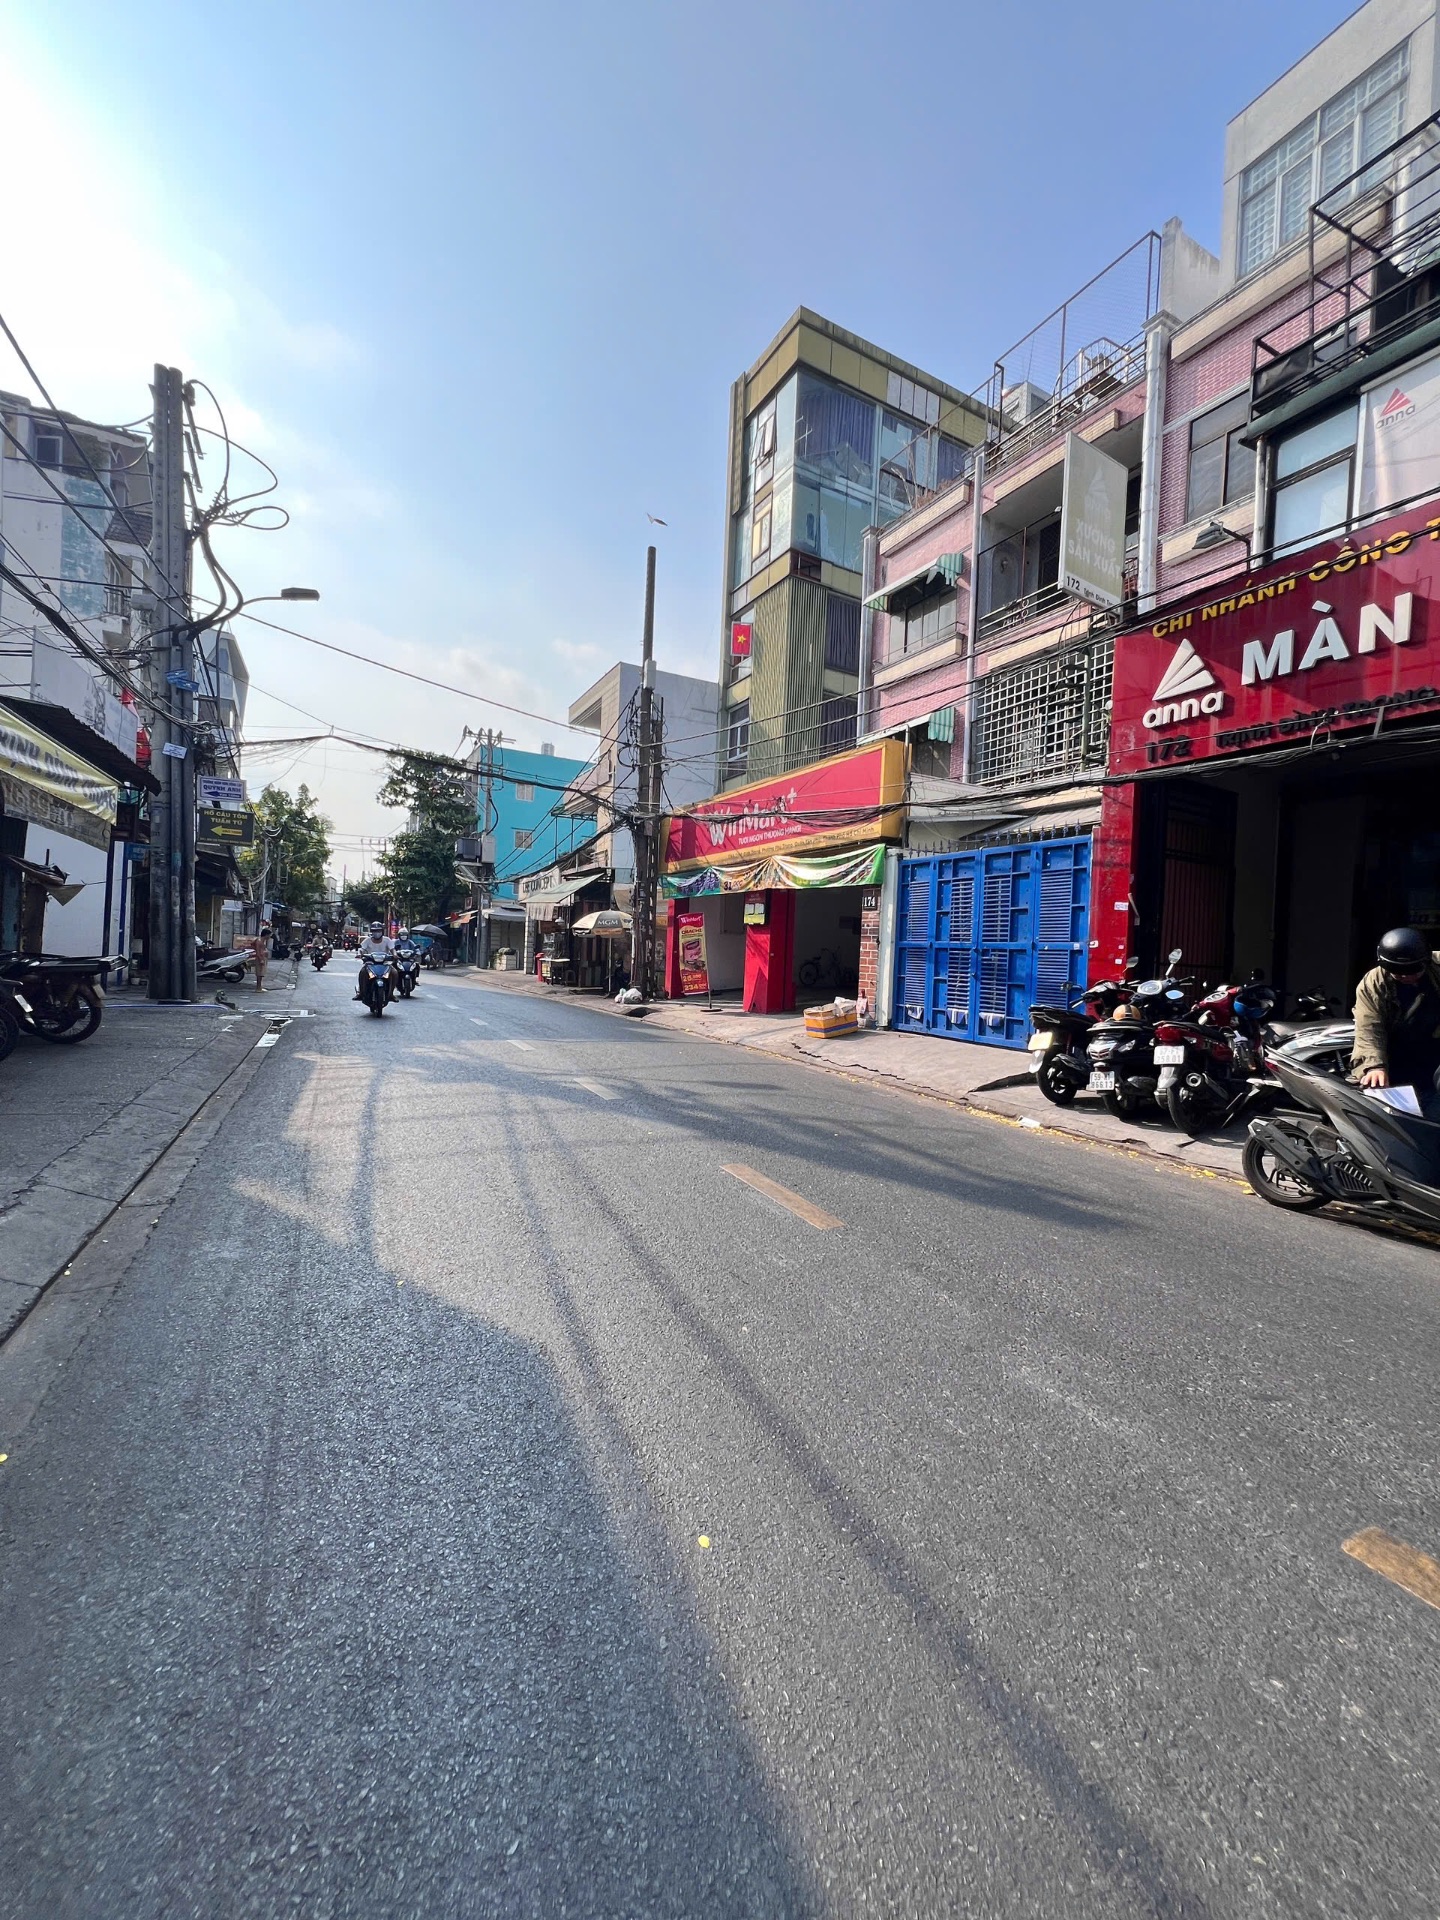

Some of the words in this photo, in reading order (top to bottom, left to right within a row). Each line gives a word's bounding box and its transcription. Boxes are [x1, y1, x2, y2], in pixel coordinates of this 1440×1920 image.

[1376, 404, 1416, 429] anna
[1066, 575, 1081, 592] 172
[1151, 612, 1192, 638] CHI
[1202, 571, 1297, 622] NHÁNH
[1308, 530, 1413, 583] CÔNG
[1241, 592, 1414, 686] MÀN
[1142, 690, 1225, 730] anna
[1145, 735, 1193, 763] 172
[864, 896, 876, 907] 174
